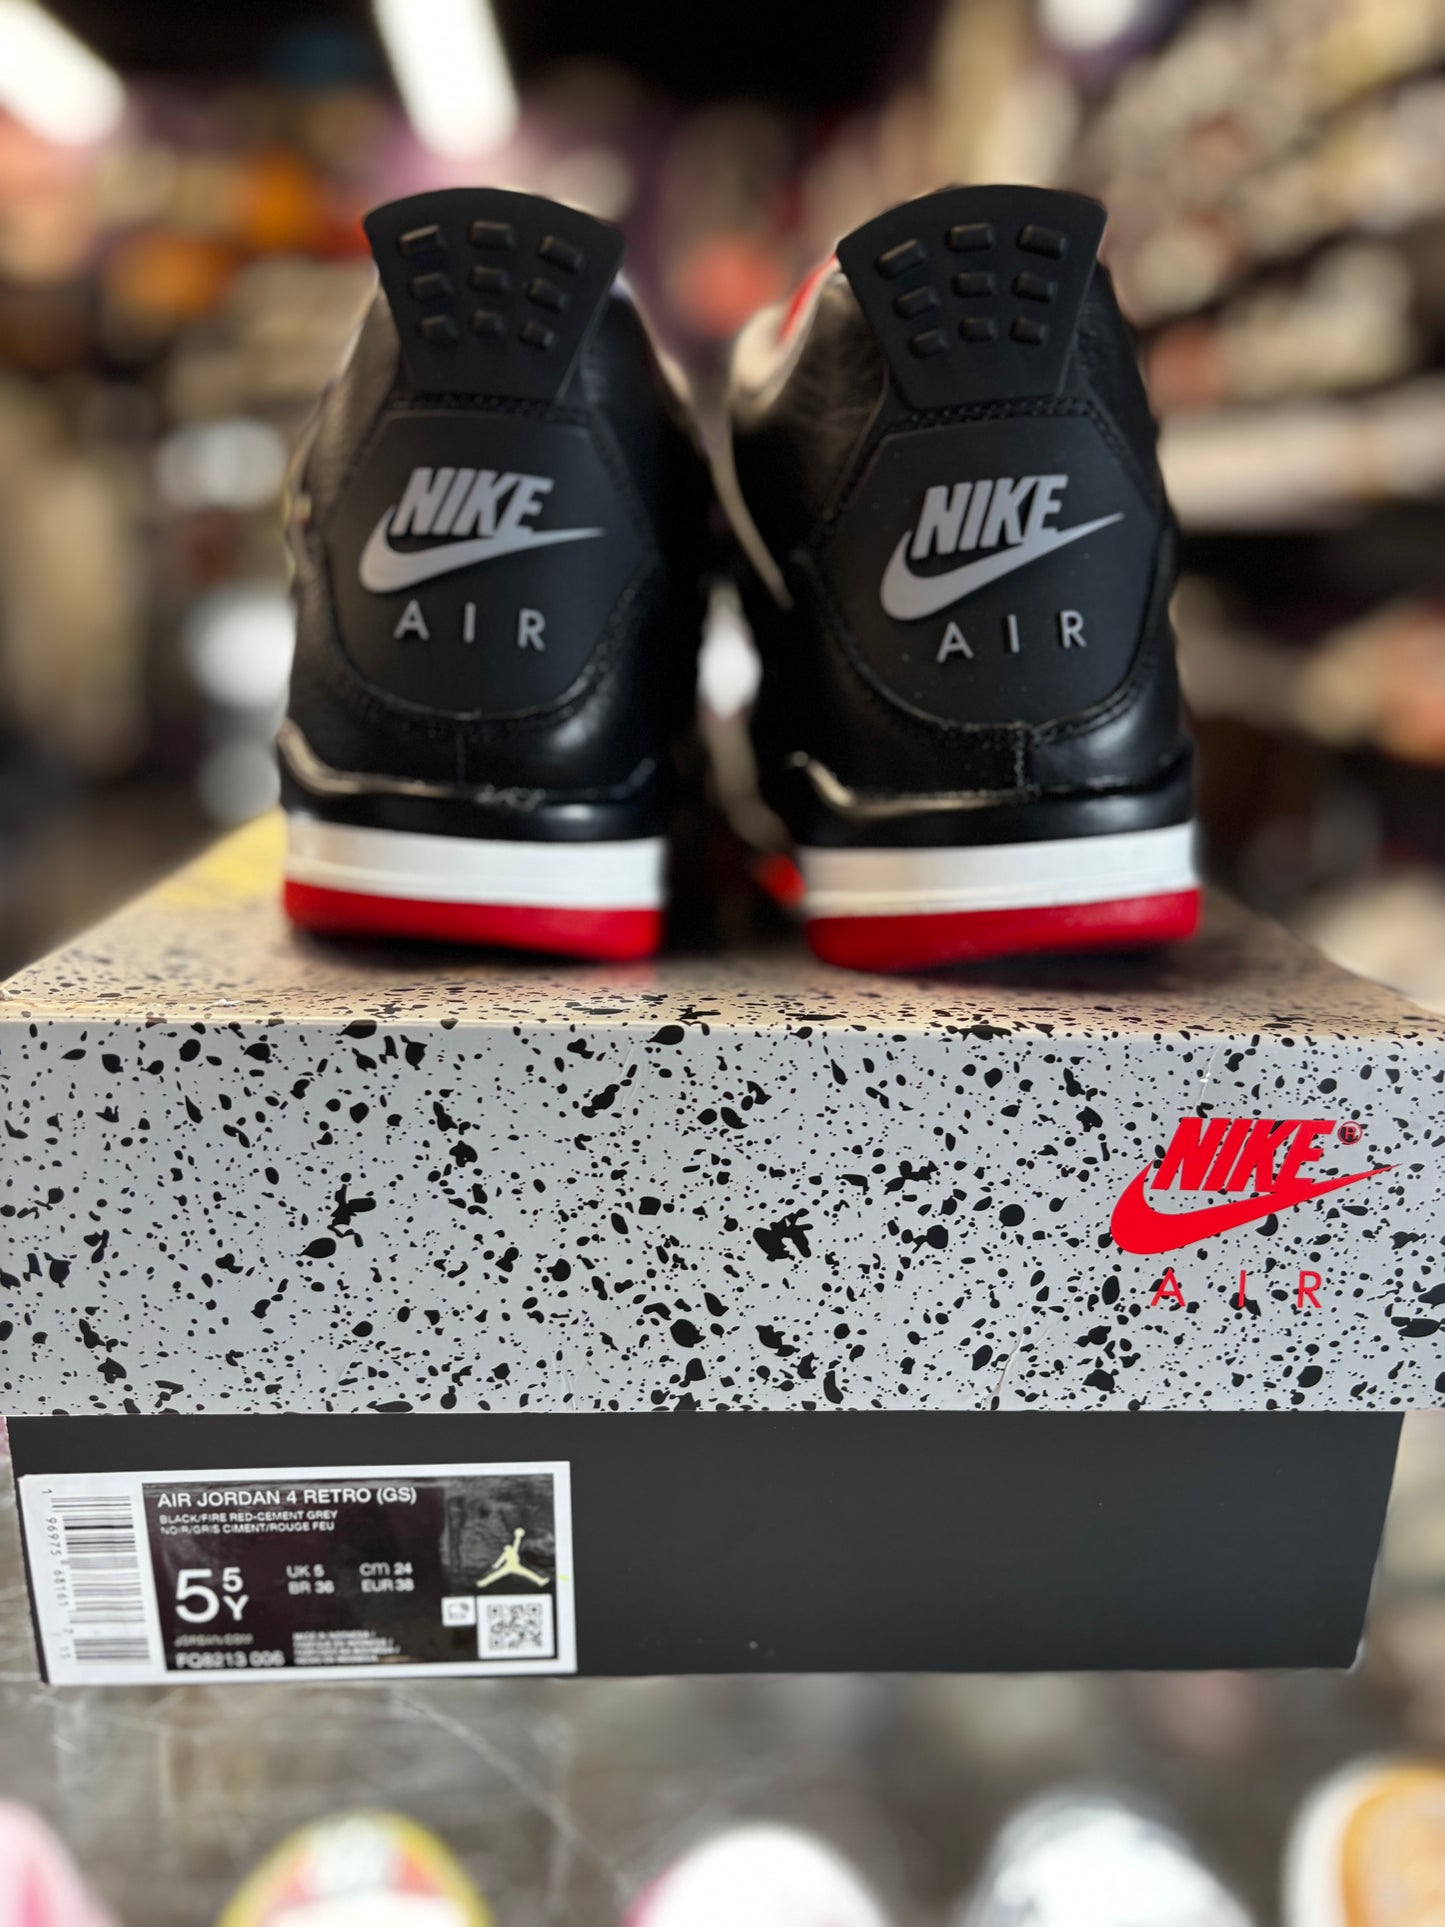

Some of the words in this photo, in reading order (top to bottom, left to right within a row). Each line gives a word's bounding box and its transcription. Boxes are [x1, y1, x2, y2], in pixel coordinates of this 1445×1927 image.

[389, 467, 555, 538] NIKE
[910, 474, 1069, 560] NIKE
[393, 599, 546, 651] AIR
[936, 609, 1087, 664] AIR
[1150, 1117, 1337, 1193] NIKE
[1150, 1268, 1323, 1309] AIR
[157, 1492, 192, 1509] AIR
[197, 1490, 280, 1507] JORDAN
[286, 1490, 298, 1505] 4
[304, 1487, 372, 1504] RETRO
[377, 1486, 417, 1505] (GS)
[159, 1512, 227, 1525] BLACK/FIRE
[229, 1511, 304, 1523] RED-CEMENT
[306, 1509, 338, 1521] GREY
[160, 1524, 221, 1536] NOIR/GRIS
[222, 1521, 310, 1534] CIMENT/ROUGE
[312, 1520, 335, 1531] FEU
[286, 1565, 311, 1578] UK
[288, 1580, 311, 1595] BR
[361, 1578, 394, 1593] EUR
[175, 1568, 220, 1624] 5
[222, 1566, 244, 1593] 5
[222, 1594, 249, 1621] Y
